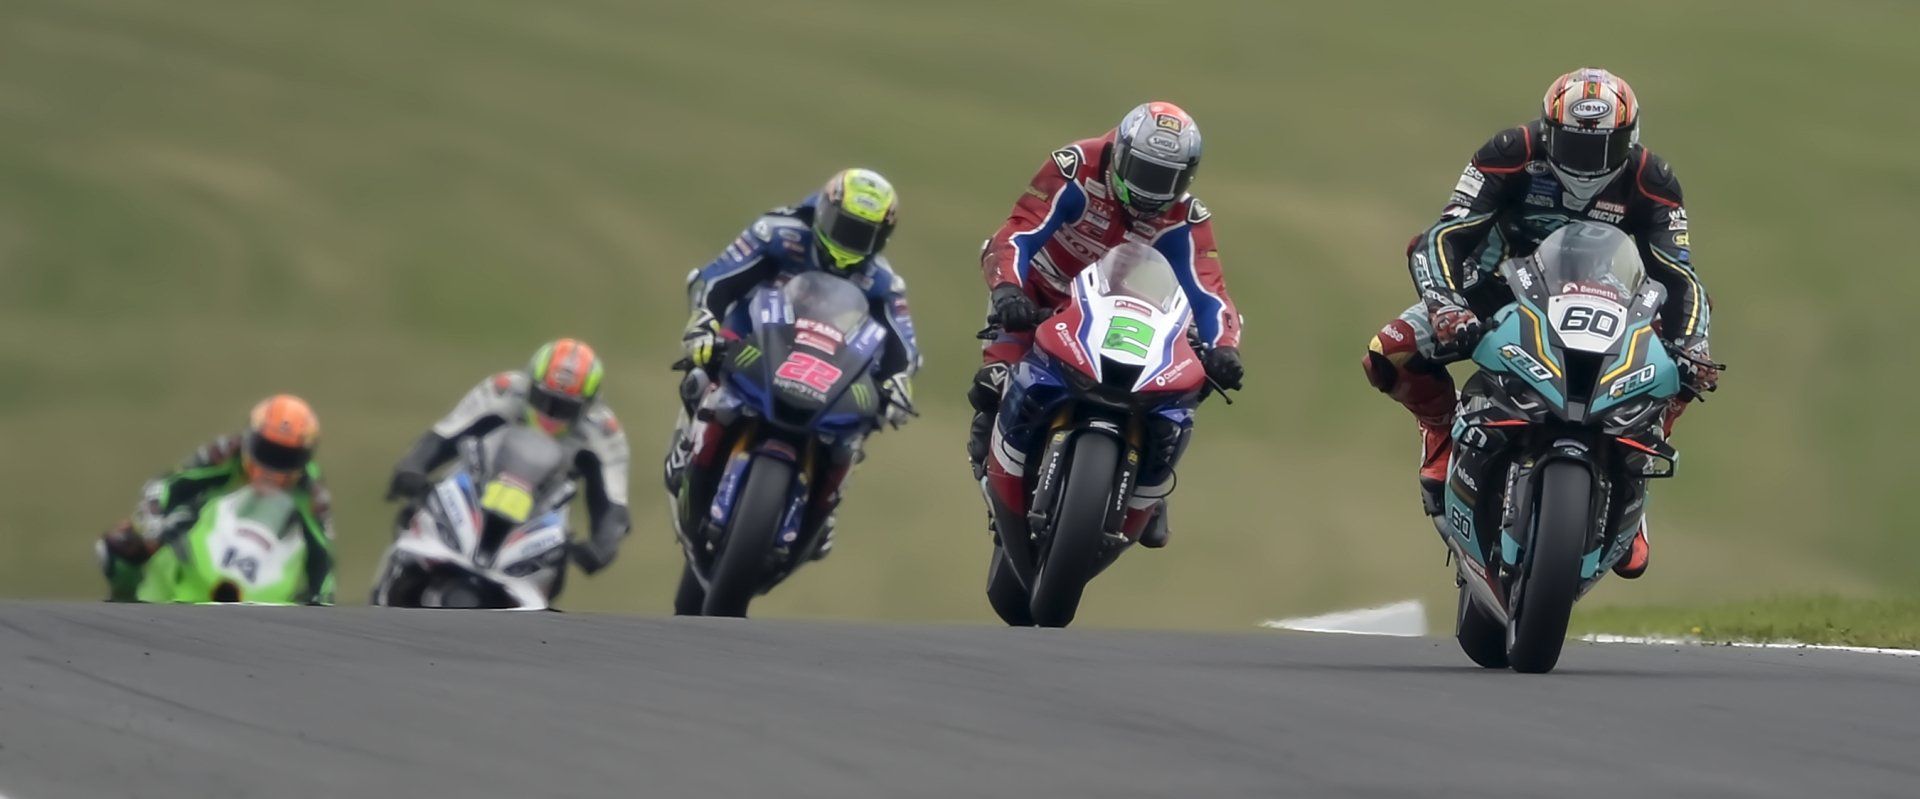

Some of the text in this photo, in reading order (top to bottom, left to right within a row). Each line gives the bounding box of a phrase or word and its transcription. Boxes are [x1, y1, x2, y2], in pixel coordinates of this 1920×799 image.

[1574, 103, 1608, 114] SUOMY
[1595, 201, 1625, 214] MOTUL
[1580, 285, 1618, 301] Bennetts
[1101, 315, 1156, 360] 2
[1559, 306, 1620, 339] 60
[775, 351, 843, 394] 22
[1501, 344, 1554, 382] FHO
[1609, 364, 1655, 399] FHO
[1044, 451, 1060, 491] PIRELLI
[1116, 470, 1131, 511] PIRELLI
[1452, 506, 1471, 542] 60
